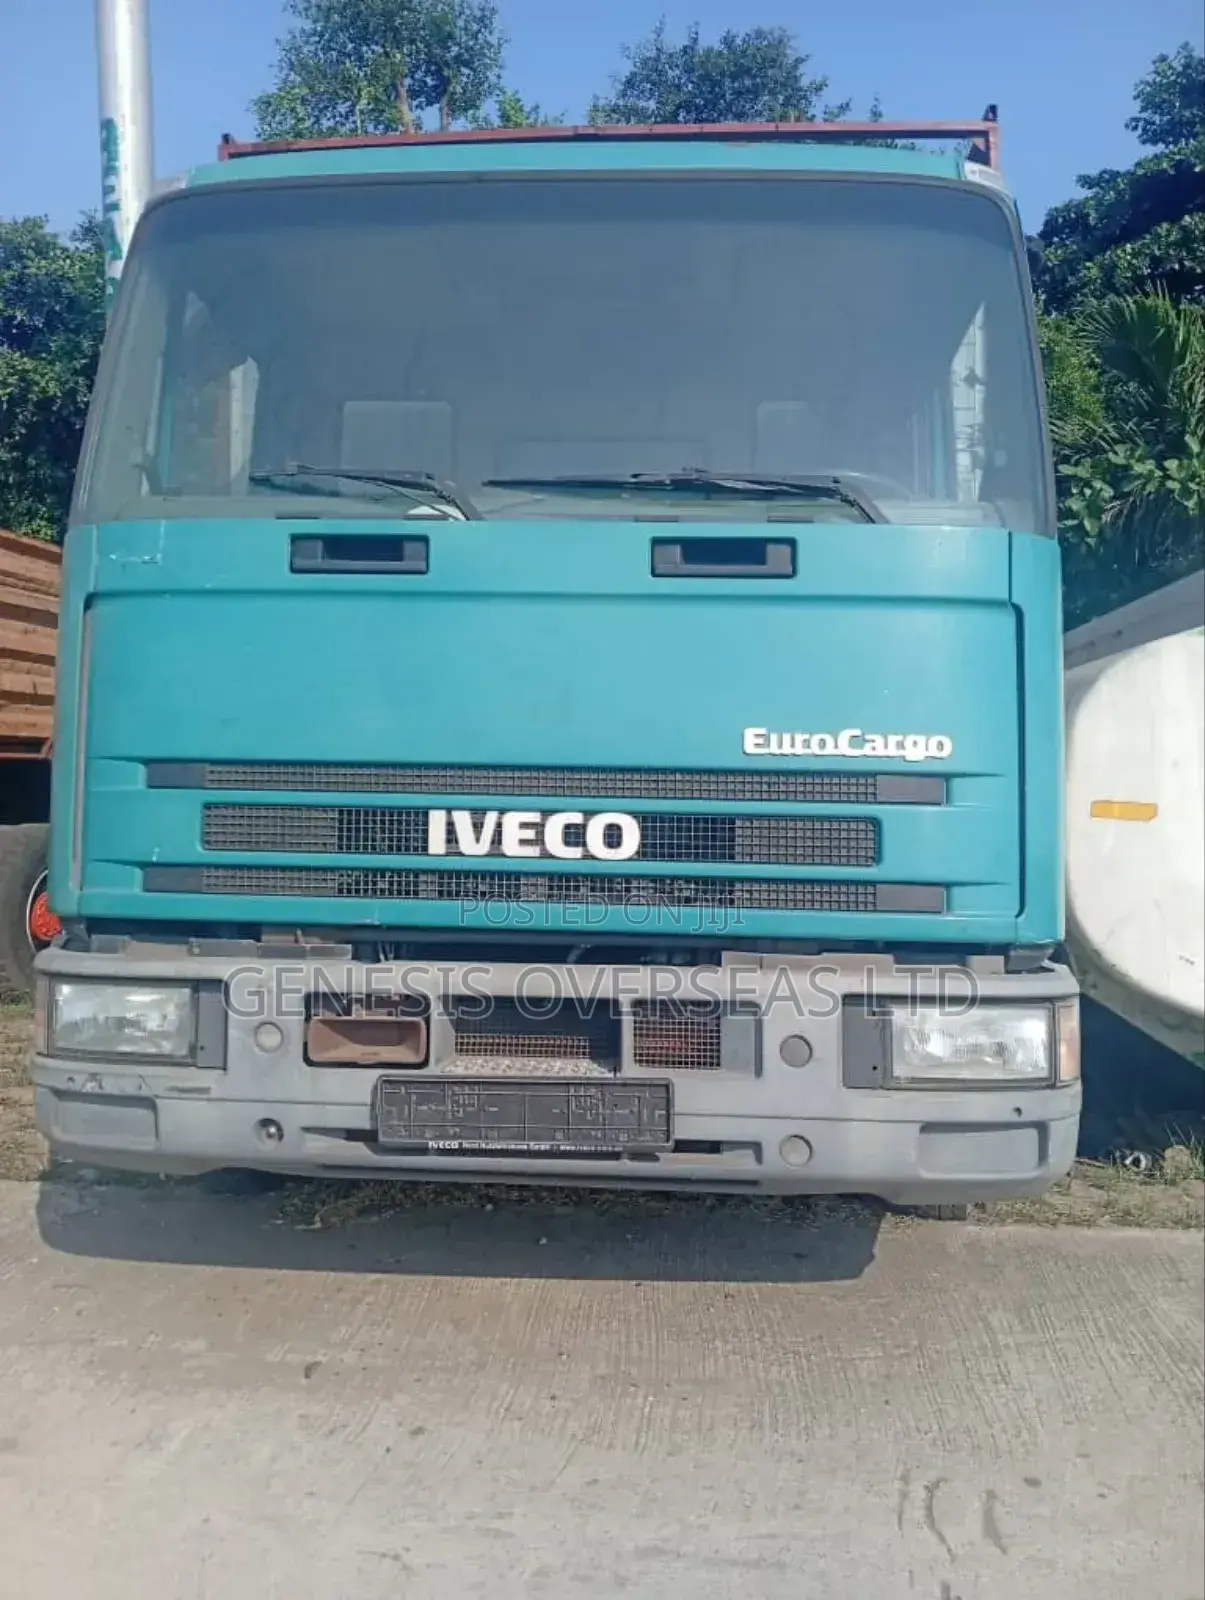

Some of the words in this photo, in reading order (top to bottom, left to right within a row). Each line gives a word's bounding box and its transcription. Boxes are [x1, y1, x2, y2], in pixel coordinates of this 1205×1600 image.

[743, 727, 952, 761] EuroCargo
[428, 809, 641, 861] IVECO
[428, 1140, 459, 1150] IVECO
